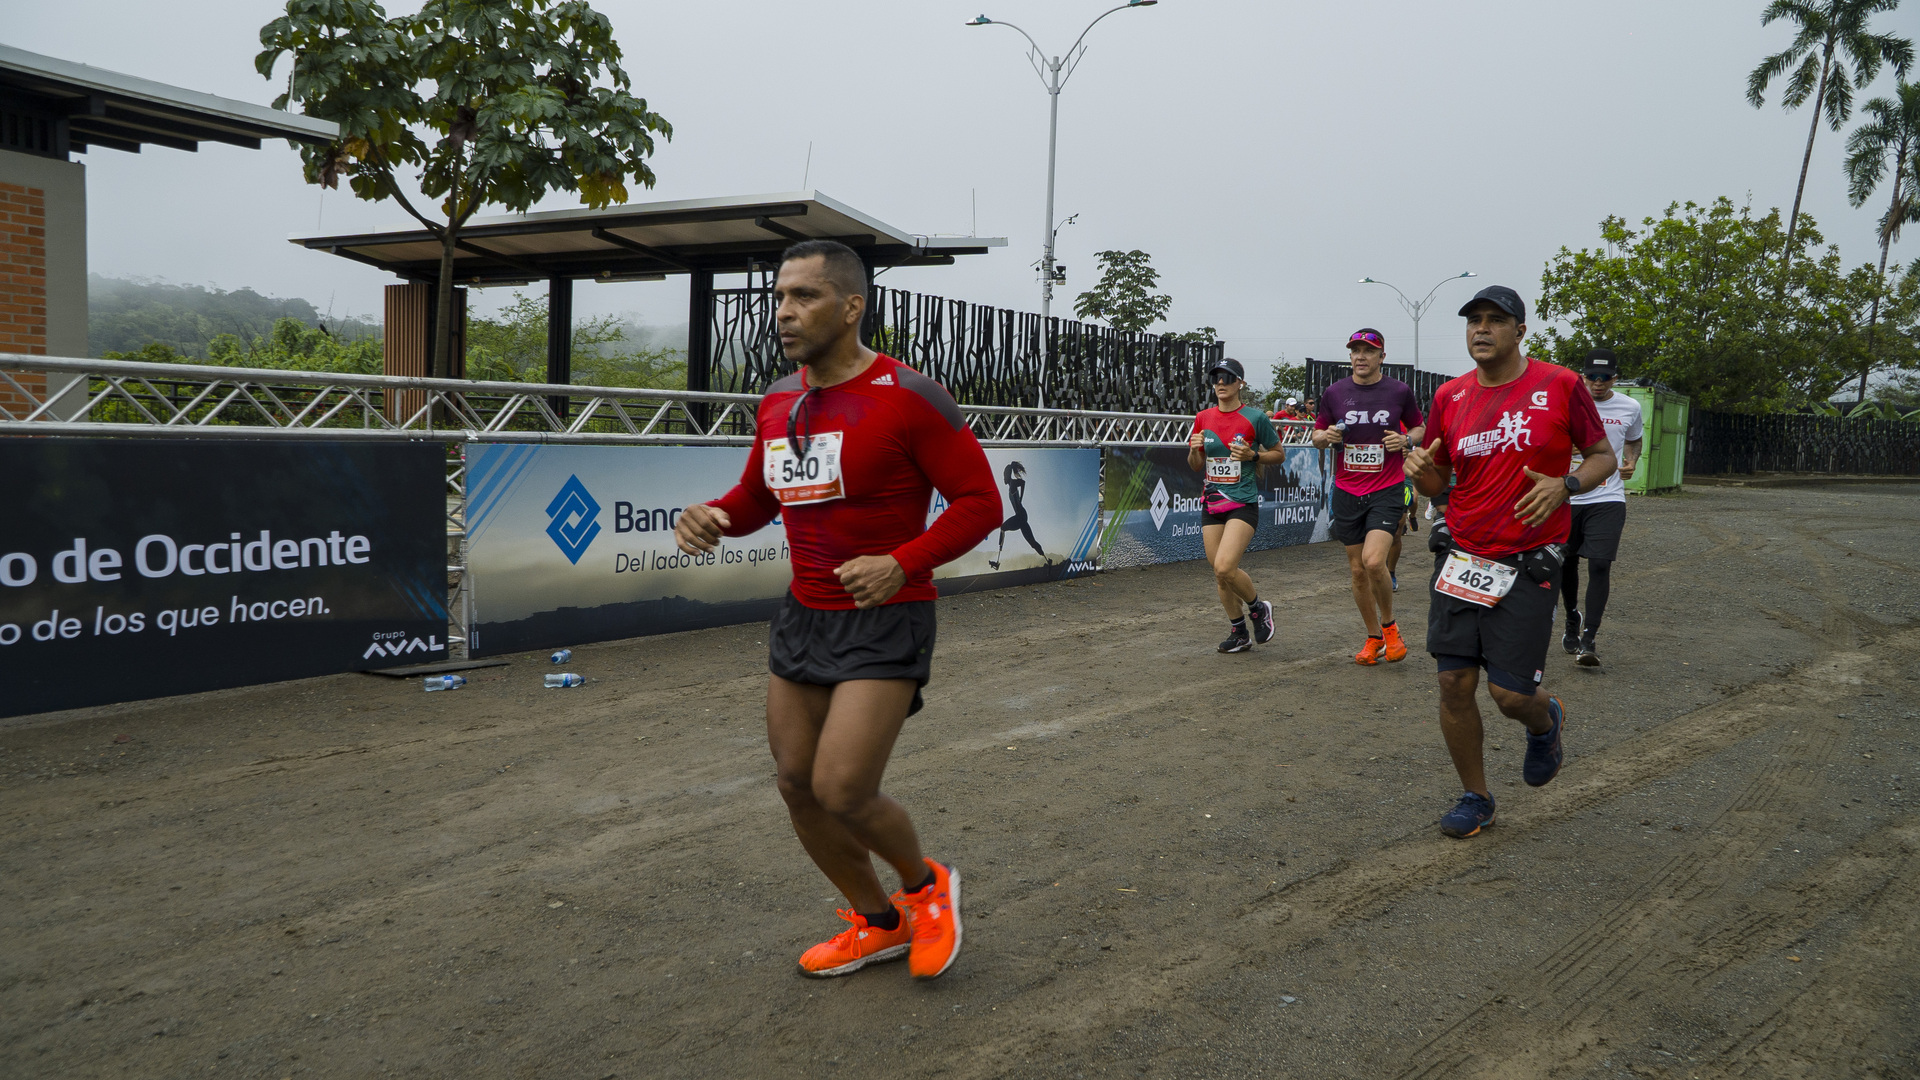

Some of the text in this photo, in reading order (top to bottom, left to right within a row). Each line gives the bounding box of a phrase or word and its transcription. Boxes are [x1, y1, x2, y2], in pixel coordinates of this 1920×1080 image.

[1457, 428, 1502, 451] ATHLETIC
[1349, 452, 1377, 463] 1625
[782, 456, 819, 483] 540
[1212, 465, 1231, 475] 192
[1273, 487, 1286, 504] TU
[1287, 486, 1318, 503] HACER,
[615, 501, 687, 533] Banc
[1274, 505, 1317, 526] IMPACTA.
[52, 537, 123, 584] de
[135, 529, 371, 578] Occidente
[615, 550, 646, 574] Del
[651, 548, 691, 571] lado
[694, 550, 716, 567] de
[720, 544, 743, 565] los
[748, 547, 777, 567] que
[1067, 560, 1095, 573] AVAL
[1458, 569, 1494, 592] 462
[32, 609, 82, 641] de
[94, 605, 146, 636] los
[156, 607, 220, 637] que
[229, 595, 331, 623] hacen.
[372, 630, 406, 640] Grupo
[362, 635, 445, 660] AVAL
